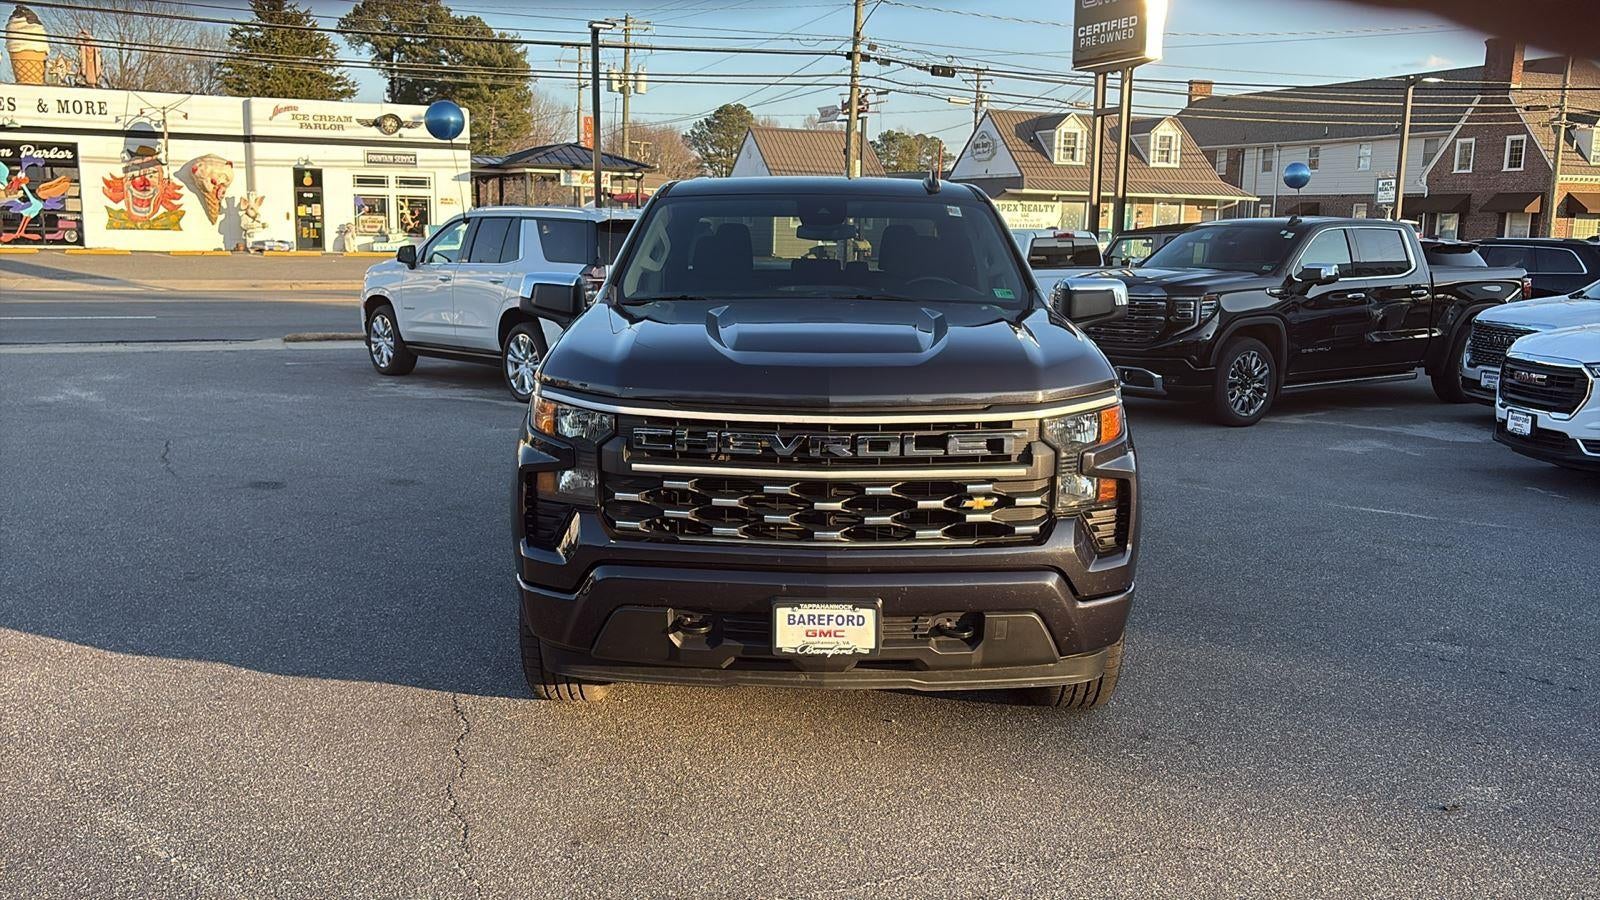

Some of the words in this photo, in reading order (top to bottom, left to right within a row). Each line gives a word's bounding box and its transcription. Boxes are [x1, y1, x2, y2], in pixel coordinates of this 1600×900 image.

[1078, 16, 1138, 37] CERTIFIED
[1080, 28, 1134, 48] PRE-OWNED
[37, 98, 48, 113] &
[56, 99, 107, 115] MORE
[291, 113, 309, 121] ICE
[312, 114, 352, 123] CREAM
[299, 122, 345, 131] PARLOR
[20, 144, 74, 159] Parlor
[367, 154, 393, 162] FOUNTAIN
[394, 155, 417, 164] SERVICE
[1020, 203, 1056, 213] REALTY
[1514, 371, 1547, 386] GMC
[633, 428, 1027, 457] CHEVROLET
[787, 614, 866, 626] BAREFORD
[805, 629, 845, 638] GMC
[797, 644, 857, 658] Bareford
